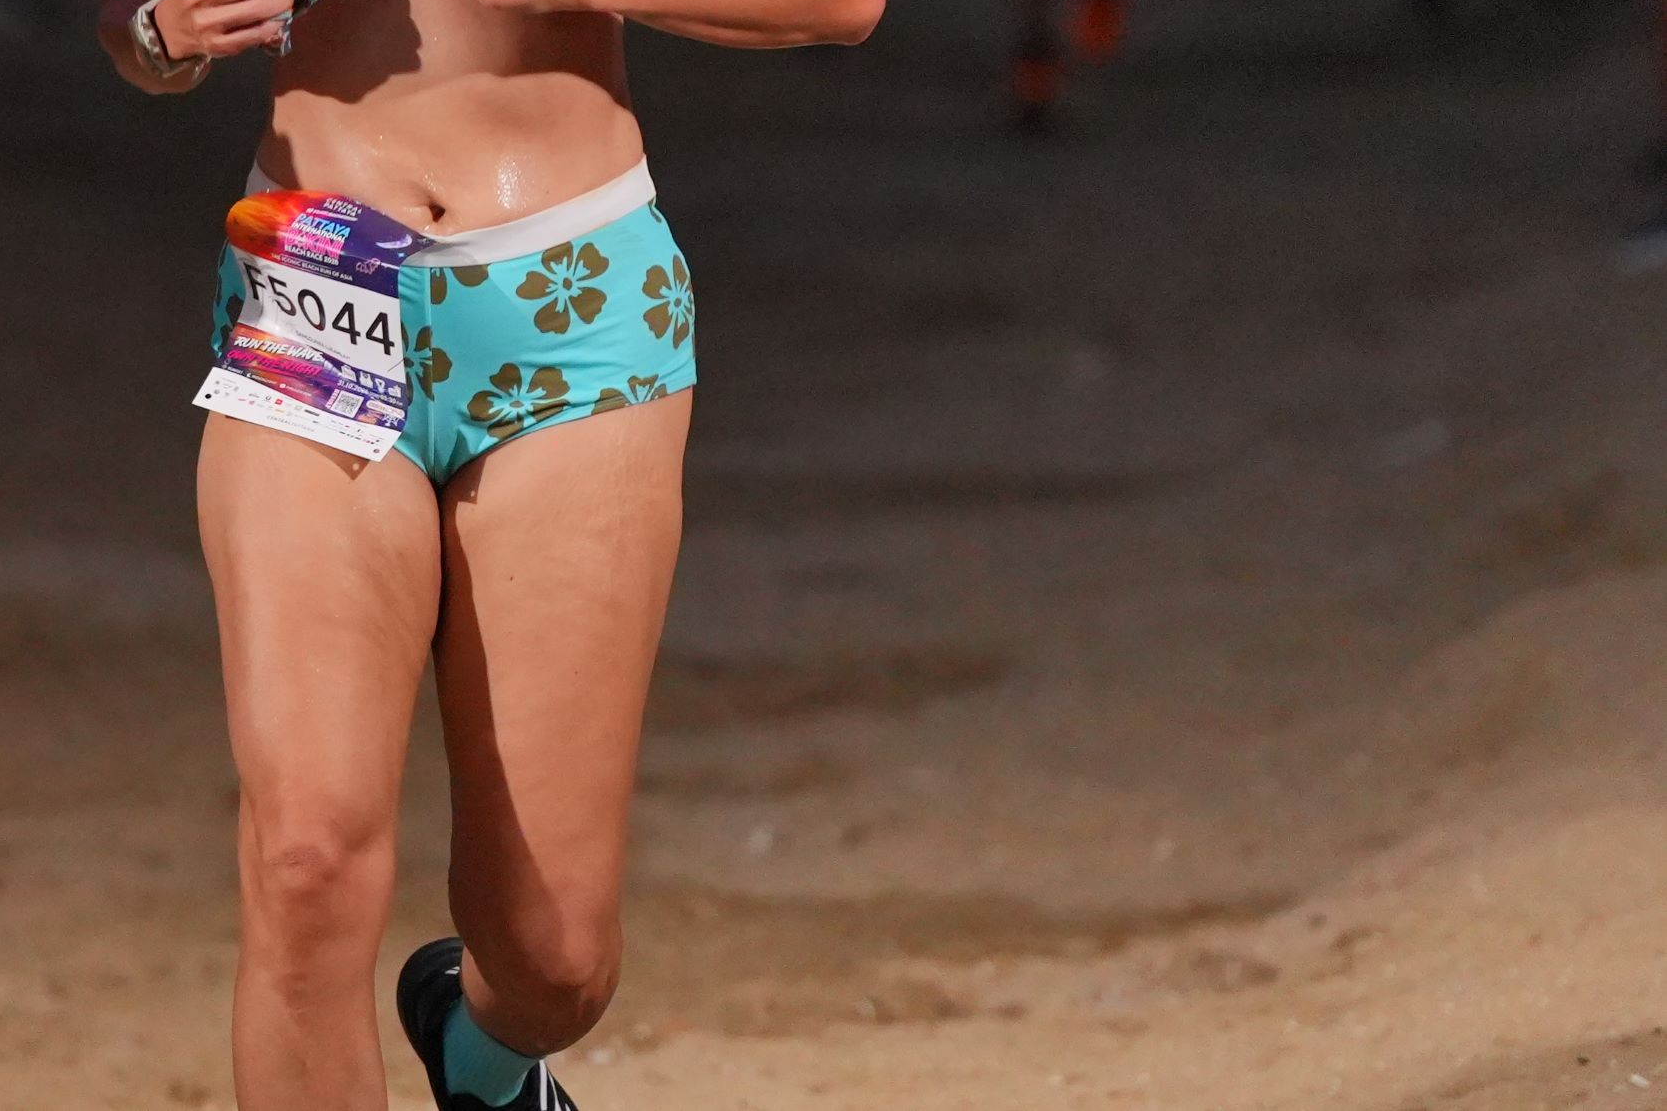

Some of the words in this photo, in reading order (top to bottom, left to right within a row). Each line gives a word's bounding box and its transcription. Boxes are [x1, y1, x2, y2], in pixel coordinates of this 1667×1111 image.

[292, 222, 346, 242] INTERNATIONAL
[296, 213, 351, 237] PATTAYA
[285, 244, 306, 257] BEACH
[306, 250, 323, 262] RACE
[301, 261, 319, 272] BEACH
[340, 272, 353, 281] ASIA
[243, 262, 395, 355] F5044
[234, 336, 262, 350] RUN
[262, 341, 289, 355] THE
